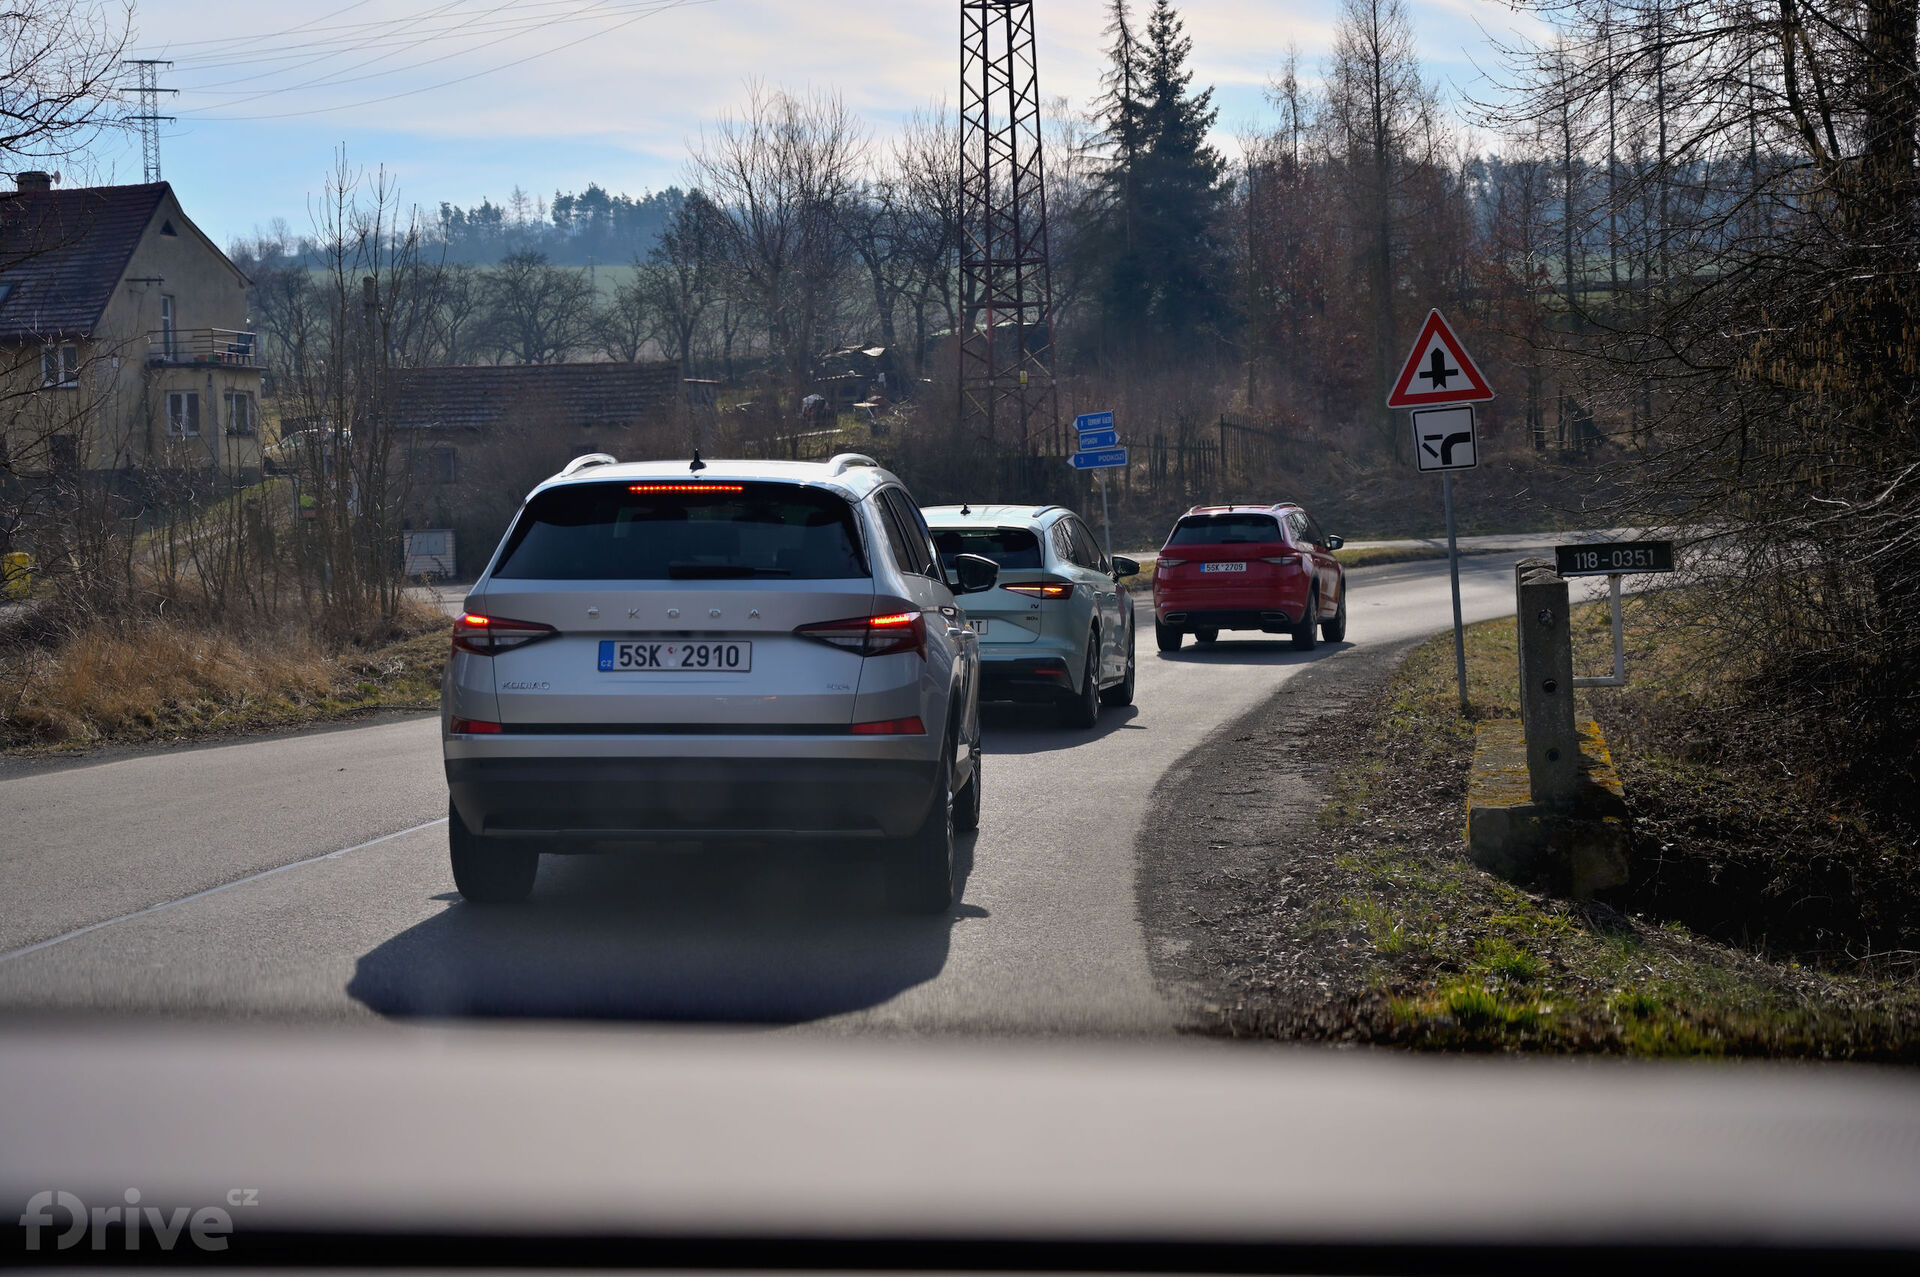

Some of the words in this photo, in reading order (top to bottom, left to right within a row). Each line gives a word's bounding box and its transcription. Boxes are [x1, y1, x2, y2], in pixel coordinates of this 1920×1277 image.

[1206, 563, 1220, 571] 5SK
[1225, 563, 1243, 571] 2709
[600, 659, 613, 668] CZ
[619, 644, 662, 667] 5SK
[681, 644, 740, 668] 2910
